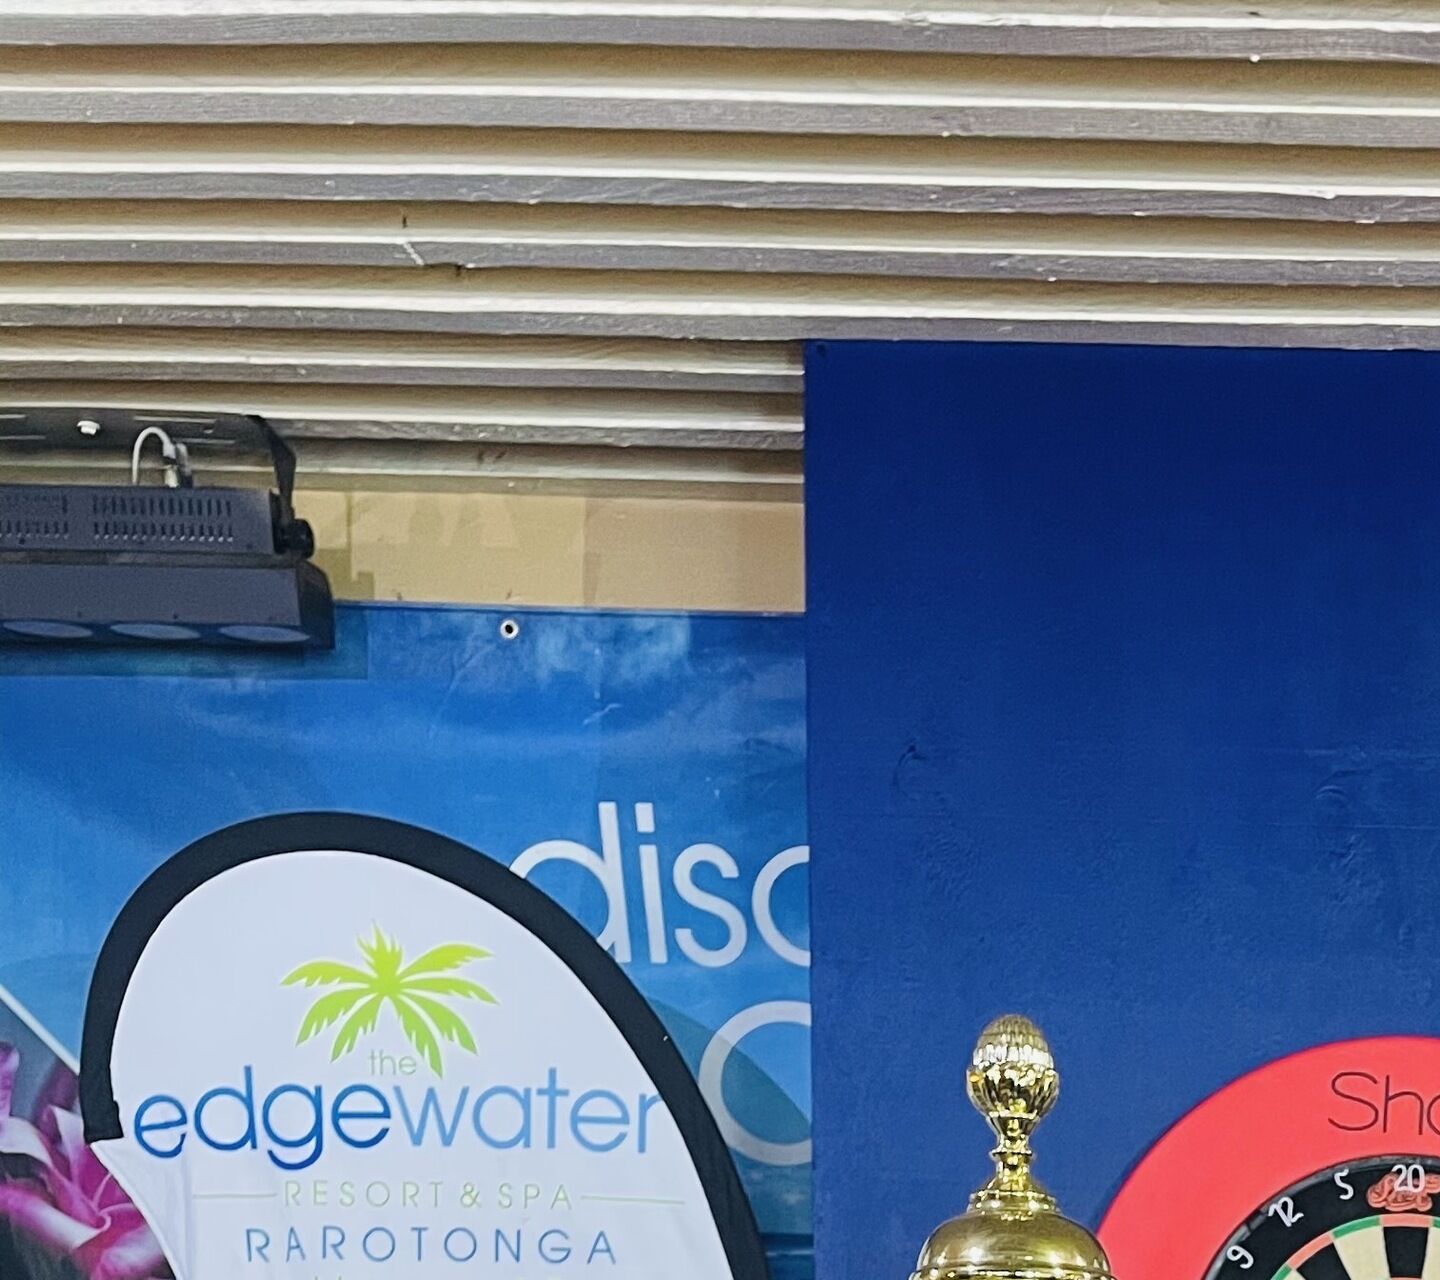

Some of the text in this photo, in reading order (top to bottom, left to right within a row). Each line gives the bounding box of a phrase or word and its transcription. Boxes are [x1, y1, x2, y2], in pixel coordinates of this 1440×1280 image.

[368, 1050, 417, 1076] the
[134, 1064, 665, 1170] edgewater
[1333, 1168, 1354, 1200] 5
[1391, 1164, 1425, 1193] 20
[284, 1180, 572, 1210] RESORT & SPA
[1268, 1196, 1304, 1227] 12
[246, 1226, 616, 1265] RAROTONGA
